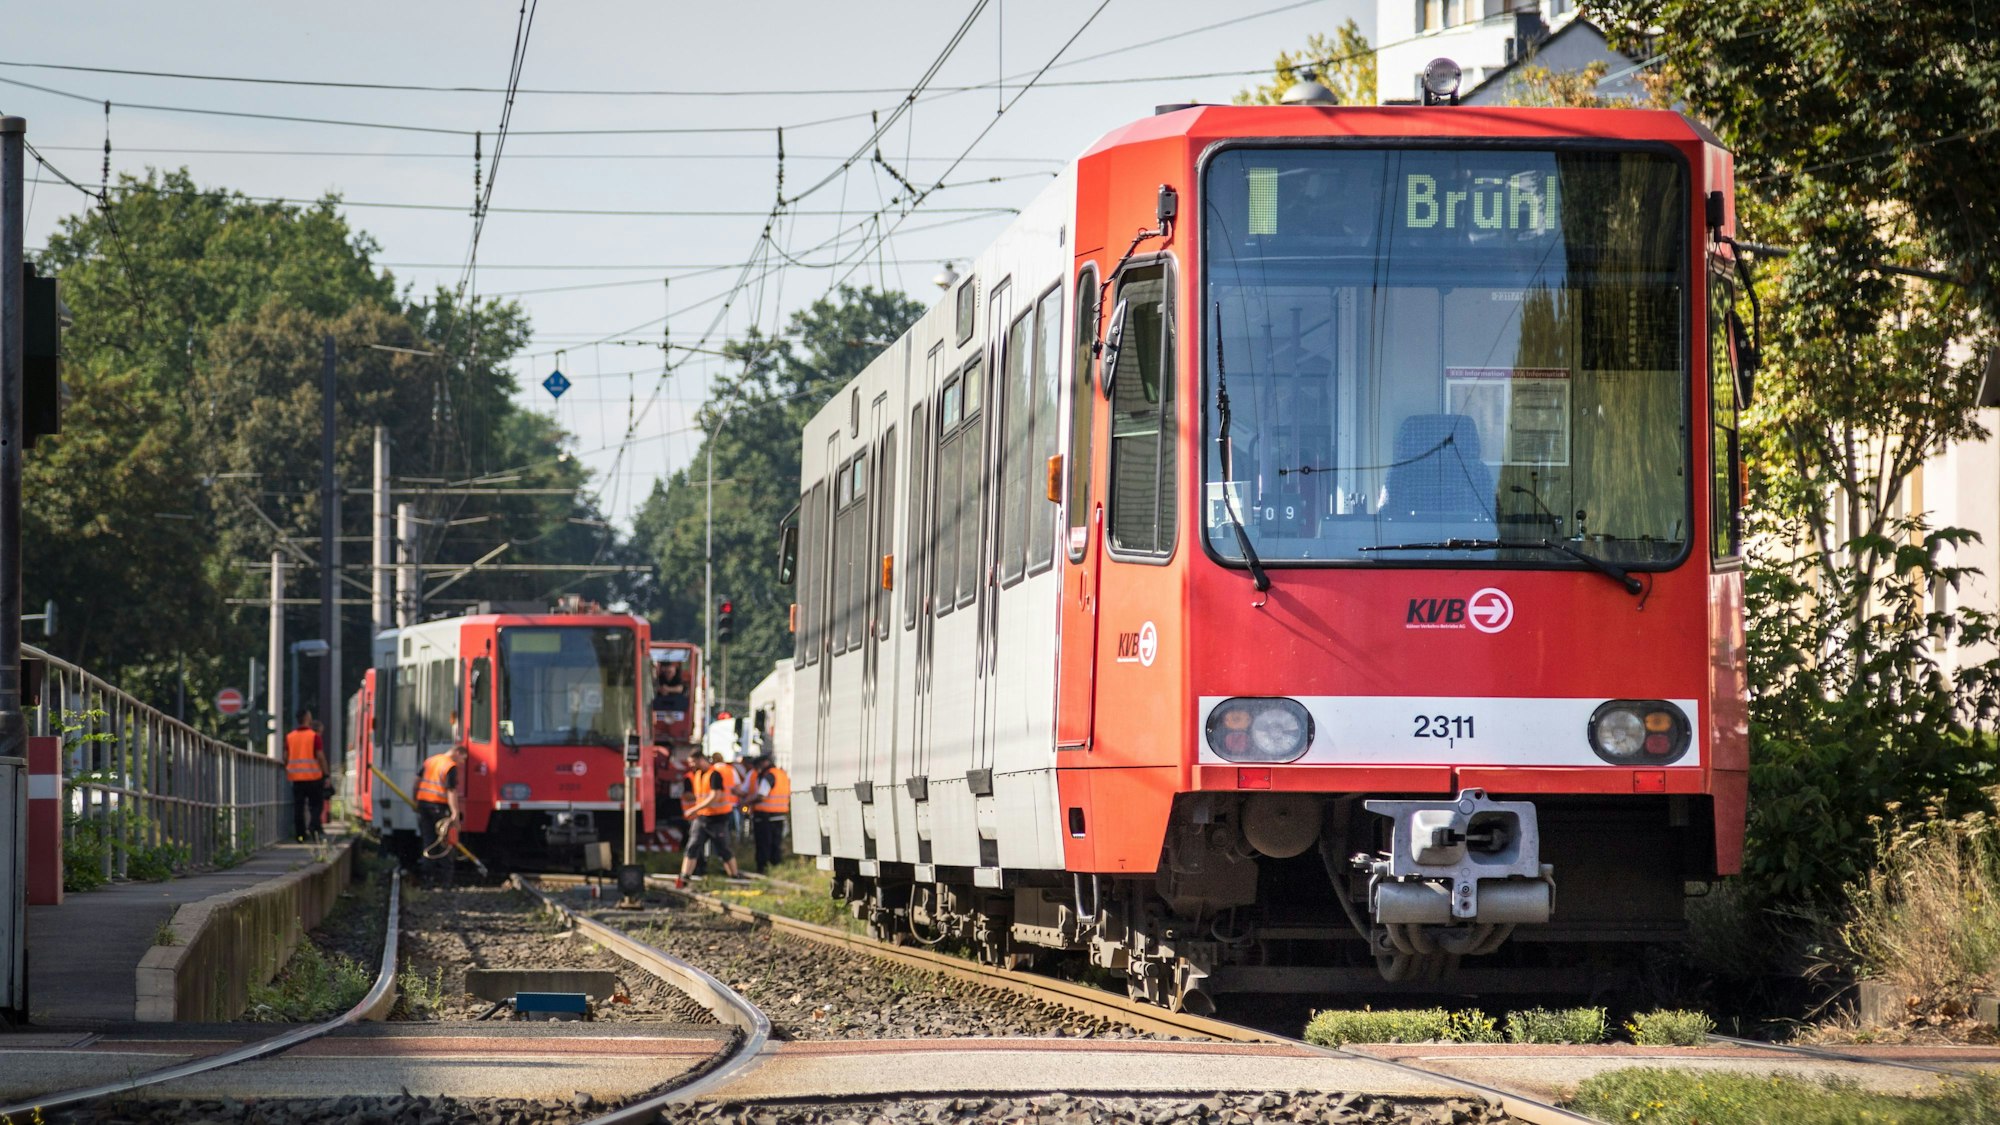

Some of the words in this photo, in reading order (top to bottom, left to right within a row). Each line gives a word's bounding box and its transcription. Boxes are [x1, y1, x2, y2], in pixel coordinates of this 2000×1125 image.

[1407, 174, 1556, 229] Brühl
[1406, 598, 1466, 623] KVB
[1118, 632, 1140, 657] KVB
[1413, 714, 1475, 739] 2311
